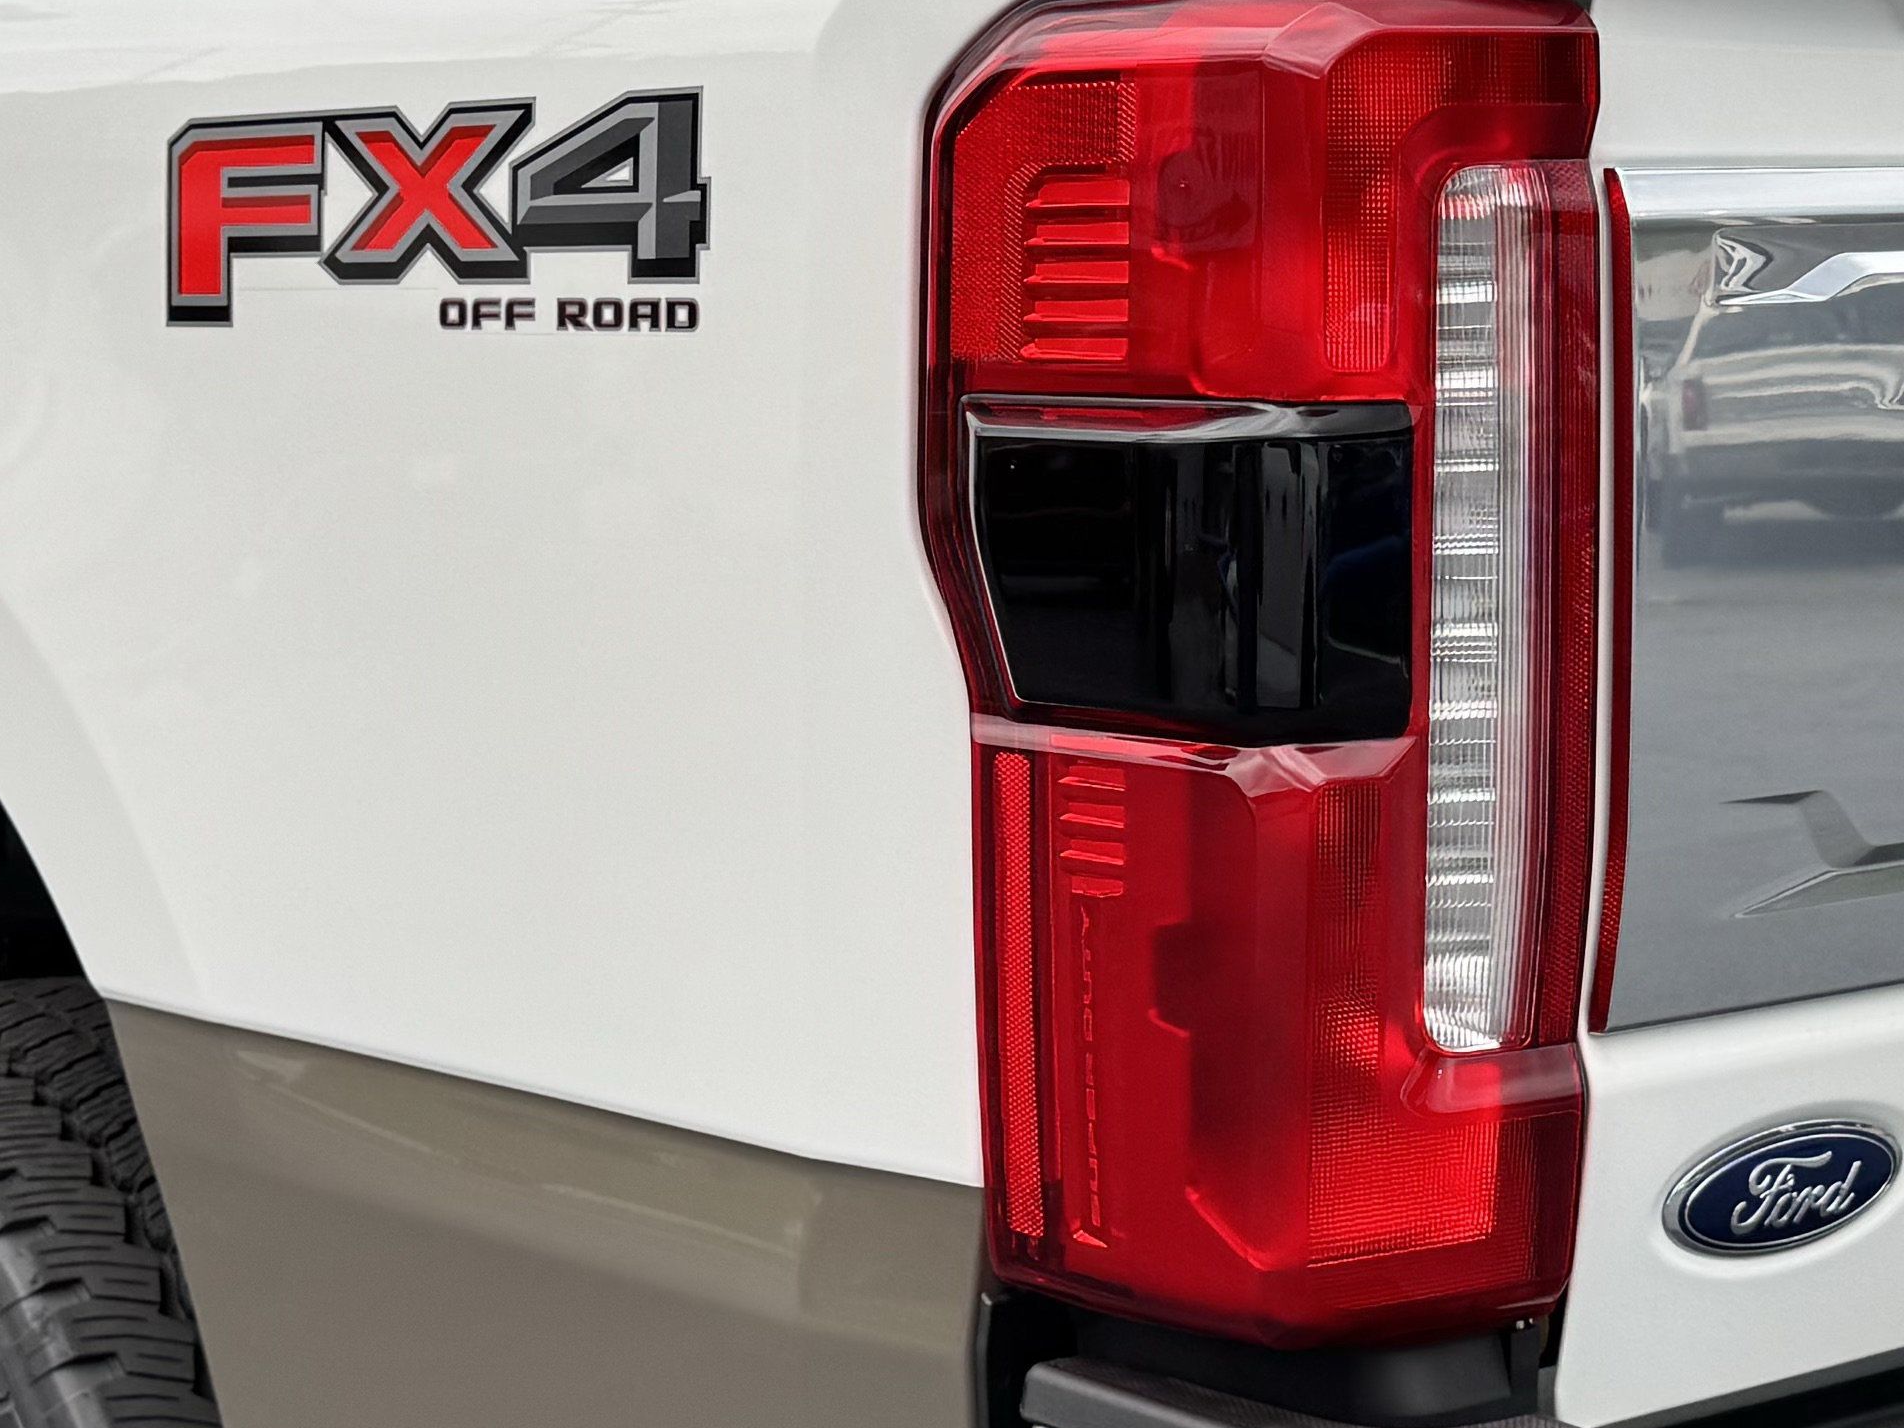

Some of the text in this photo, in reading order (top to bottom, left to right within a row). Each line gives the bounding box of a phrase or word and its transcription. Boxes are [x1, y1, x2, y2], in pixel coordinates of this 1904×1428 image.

[167, 86, 711, 327] FX4
[438, 297, 701, 332] OFF ROAD
[1730, 1149, 1862, 1235] Ford
